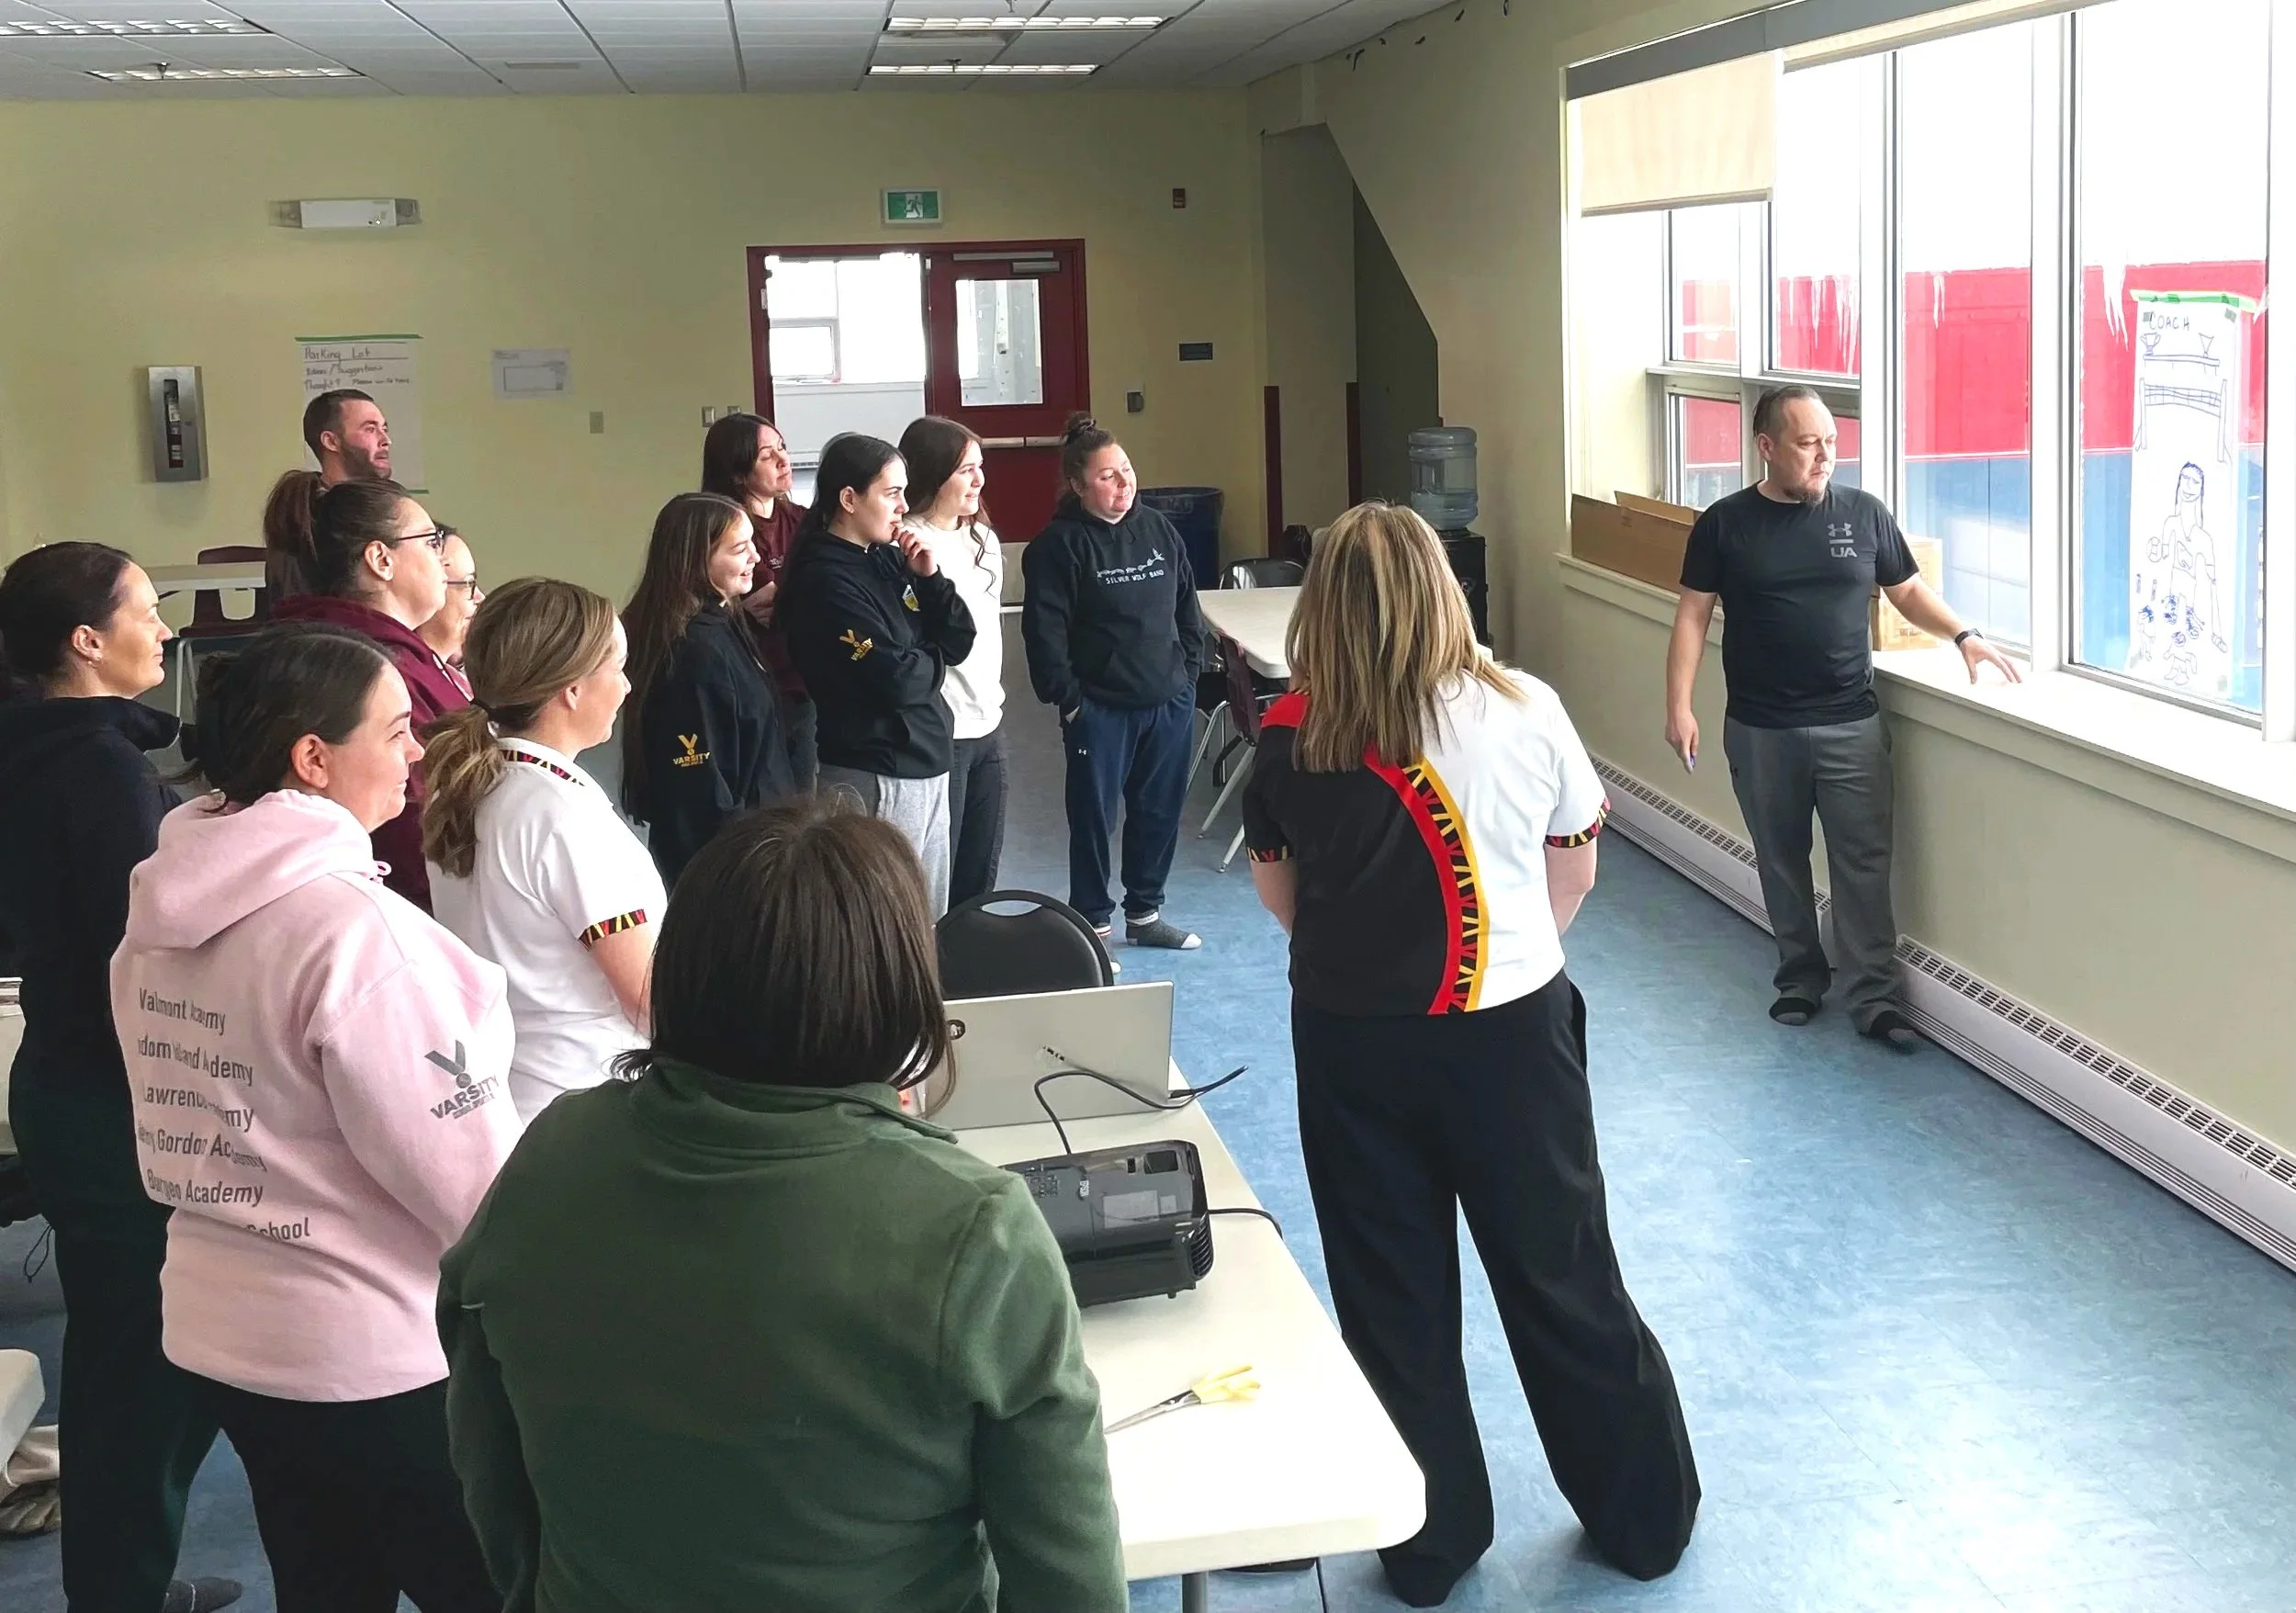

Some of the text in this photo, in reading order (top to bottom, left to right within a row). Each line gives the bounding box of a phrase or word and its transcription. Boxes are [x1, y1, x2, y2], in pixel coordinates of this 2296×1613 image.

[2149, 310, 2190, 332] COACH
[304, 346, 342, 365] Parking
[1830, 547, 1858, 558] UA
[1106, 570, 1165, 584] SILVER WOLF BAND
[672, 751, 711, 765] VARSITY
[430, 1075, 500, 1119] VARSITY
[186, 1179, 264, 1208] Academy
